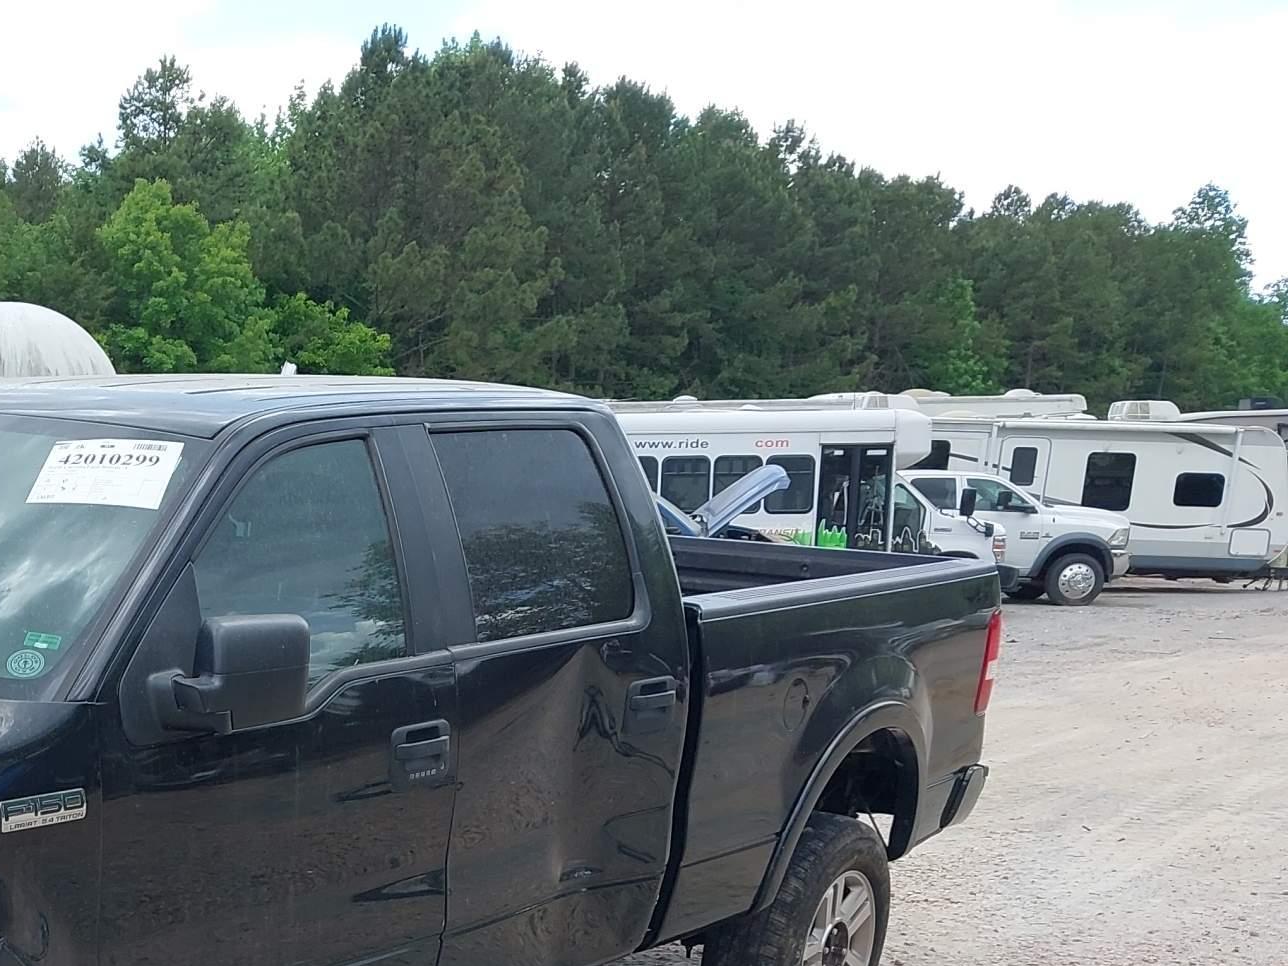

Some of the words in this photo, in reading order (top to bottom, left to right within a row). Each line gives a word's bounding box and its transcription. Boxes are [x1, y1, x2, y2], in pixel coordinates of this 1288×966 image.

[634, 438, 710, 449] www.ride
[755, 438, 790, 448] com
[58, 453, 161, 467] 42010299
[56, 811, 84, 821] TRITON
